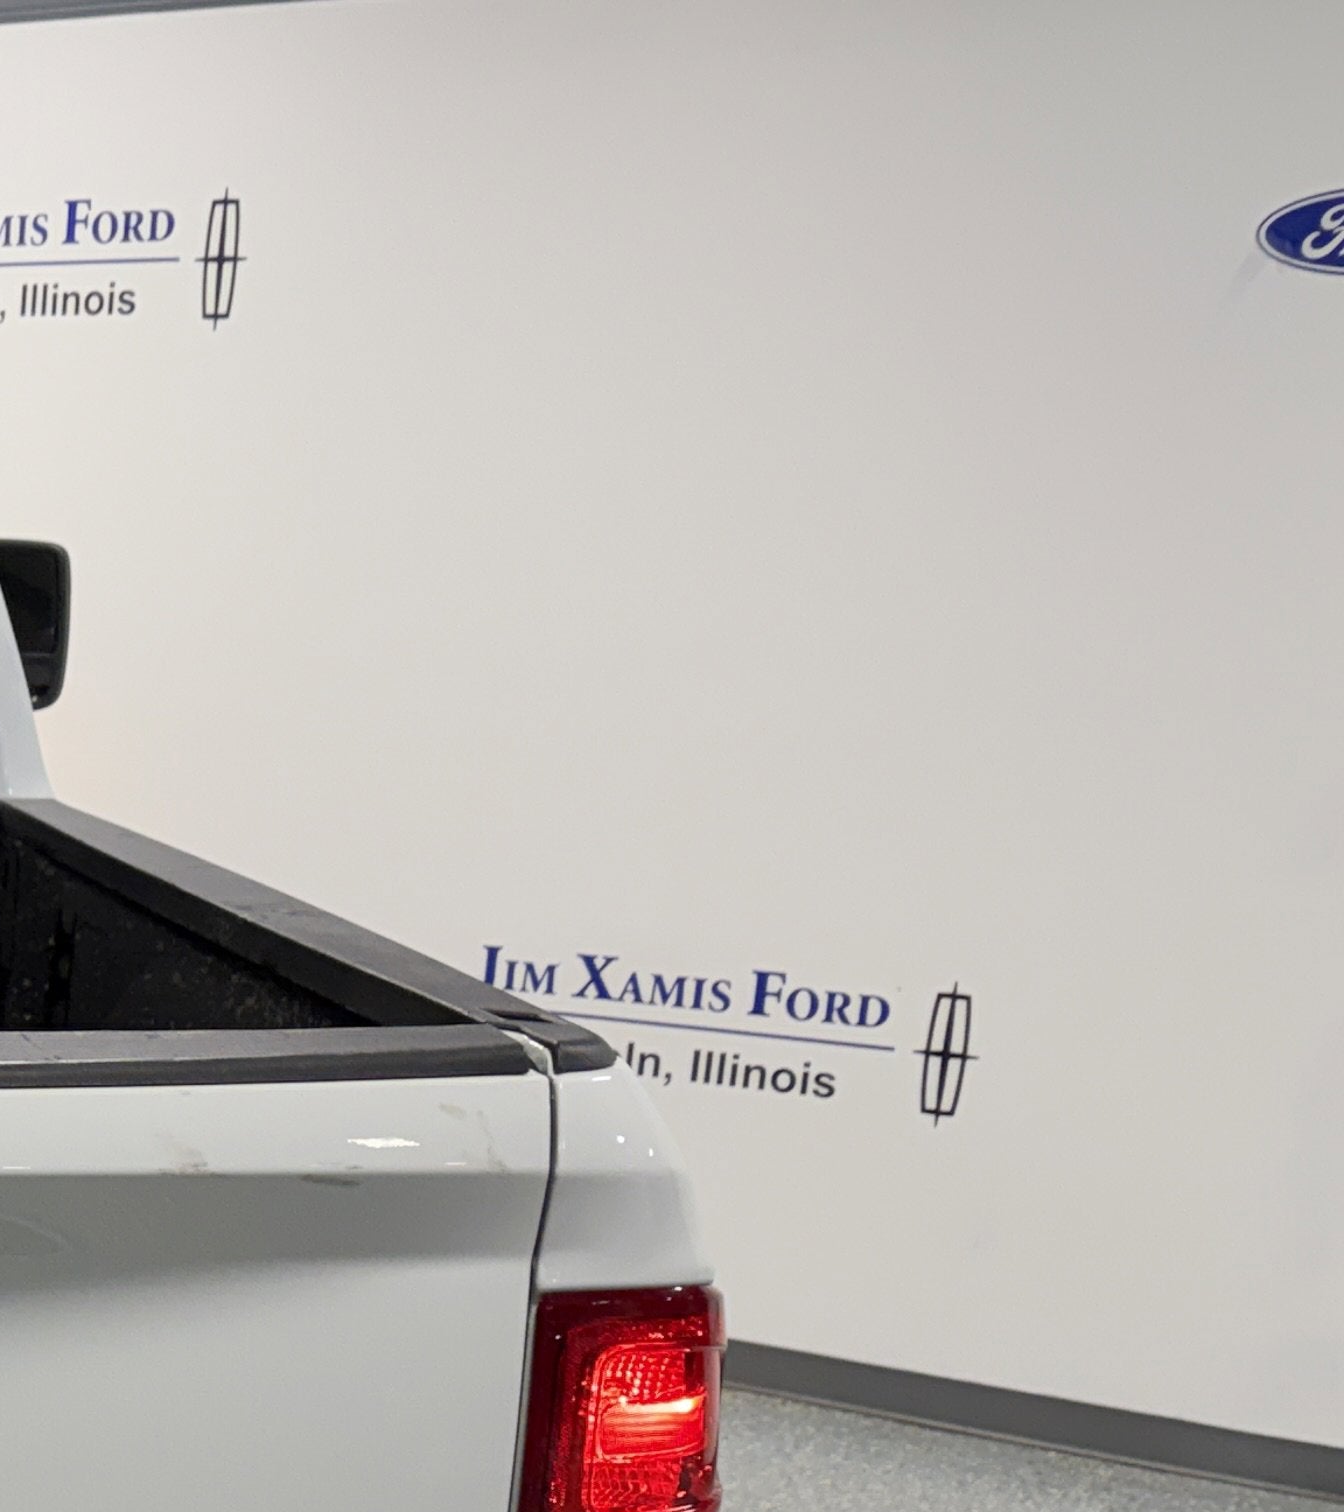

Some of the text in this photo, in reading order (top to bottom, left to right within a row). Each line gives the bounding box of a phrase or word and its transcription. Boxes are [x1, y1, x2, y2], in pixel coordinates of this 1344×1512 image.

[62, 199, 176, 246] FORD
[19, 281, 137, 317] Illinois
[571, 953, 733, 1014] XAMIS
[747, 969, 892, 1029] FORD
[689, 1048, 837, 1099] Illinois
